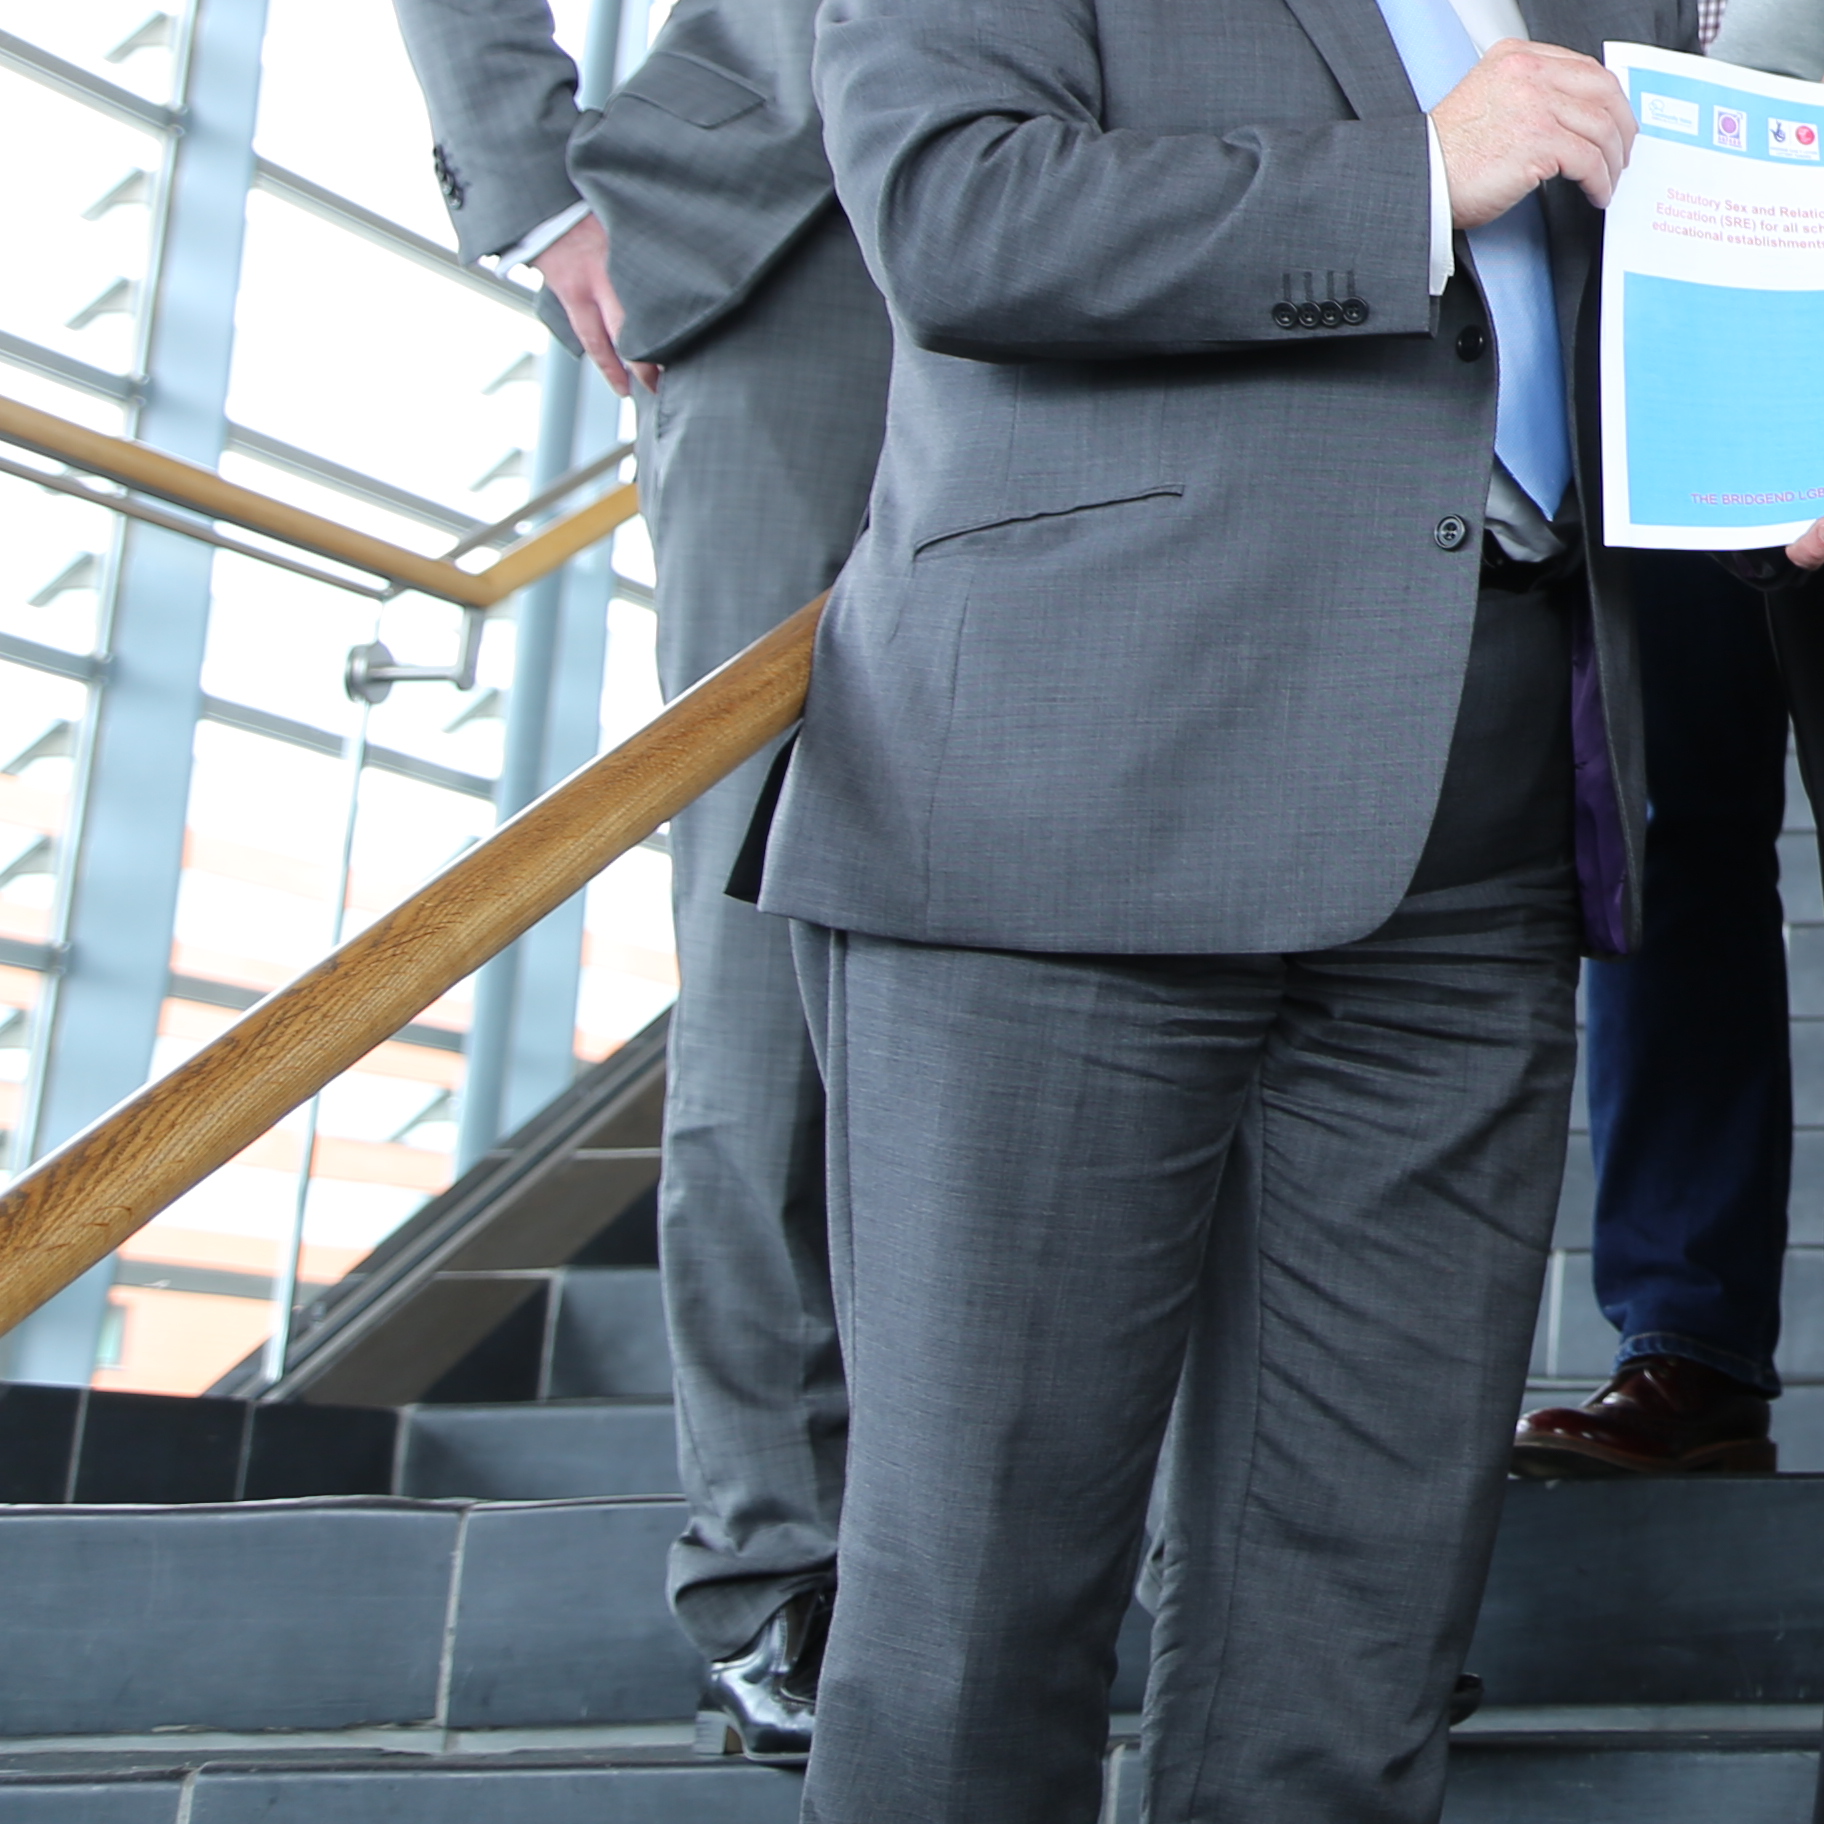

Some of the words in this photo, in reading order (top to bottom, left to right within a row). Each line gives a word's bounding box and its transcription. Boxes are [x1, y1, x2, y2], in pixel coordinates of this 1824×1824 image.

[1666, 187, 1722, 211] Statutory
[1724, 199, 1748, 214] Sex
[1751, 204, 1775, 217] and
[1652, 220, 1724, 242] educational
[1656, 202, 1717, 225] Education
[1720, 215, 1757, 232] (SRE)
[1760, 220, 1779, 233] for
[1783, 222, 1799, 234] all
[1691, 493, 1718, 505] THE
[1722, 492, 1795, 505] BRIDGEND
